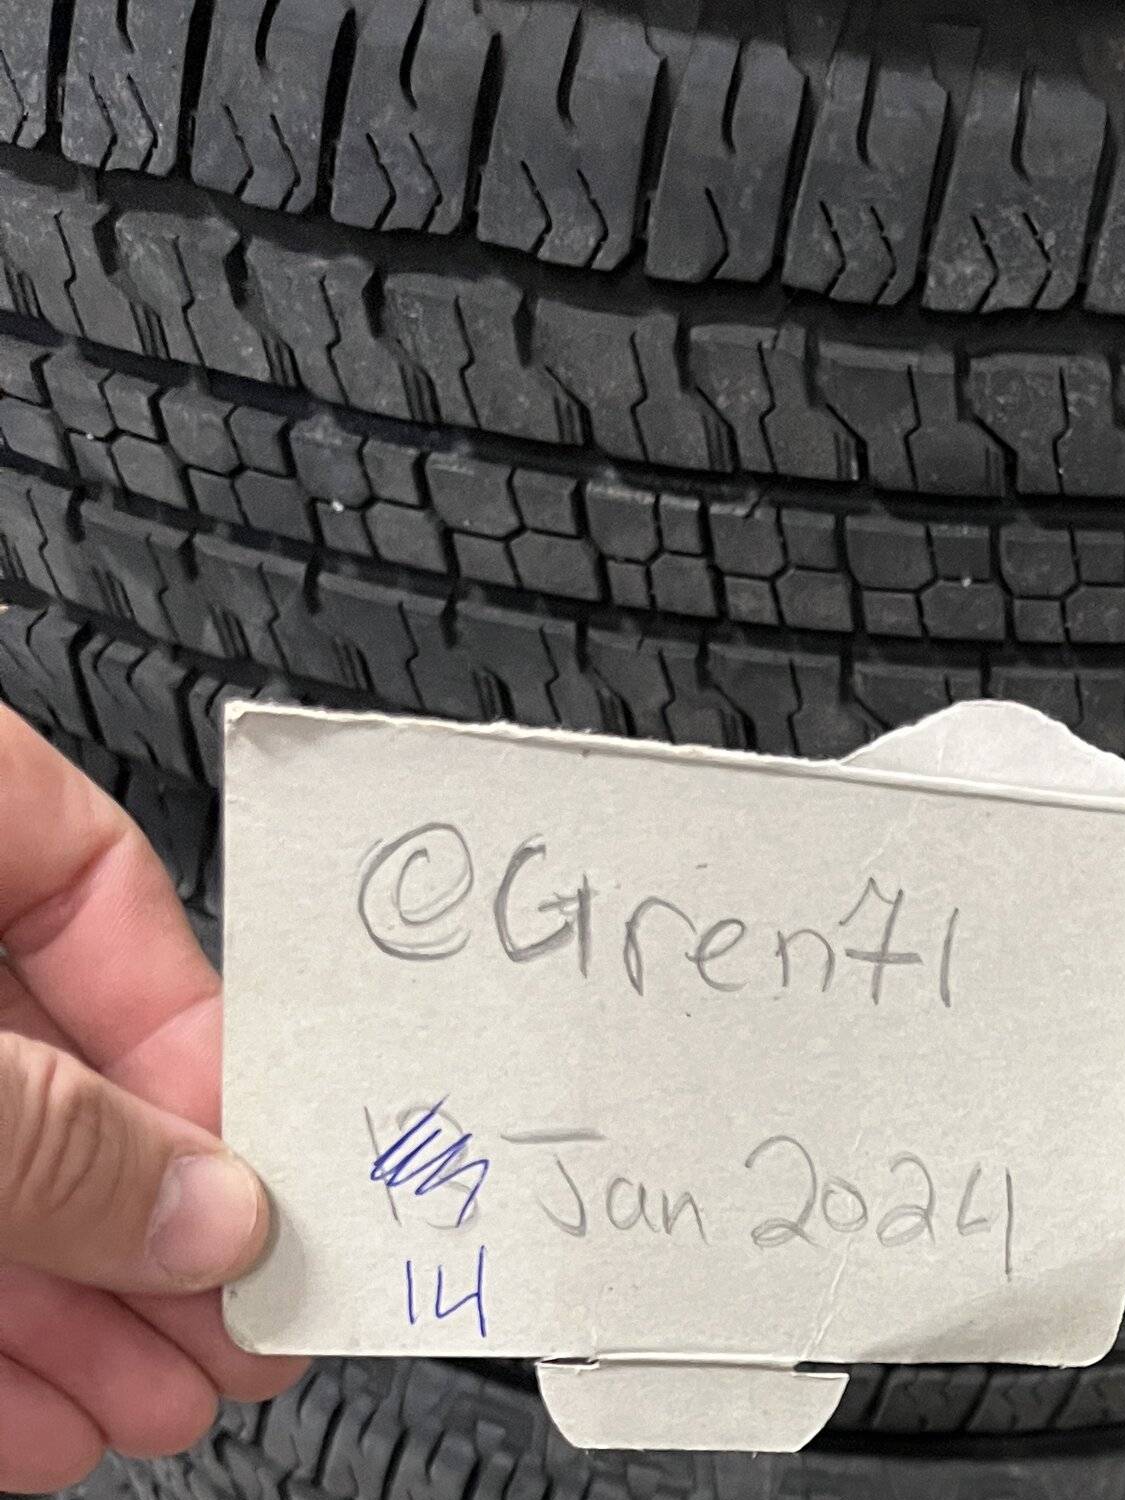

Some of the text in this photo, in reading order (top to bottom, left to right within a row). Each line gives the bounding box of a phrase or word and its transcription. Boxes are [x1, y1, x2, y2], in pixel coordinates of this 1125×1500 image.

[499, 1127, 708, 1239] Jan
[744, 1134, 1014, 1283] 2024
[404, 1244, 488, 1339] 14
